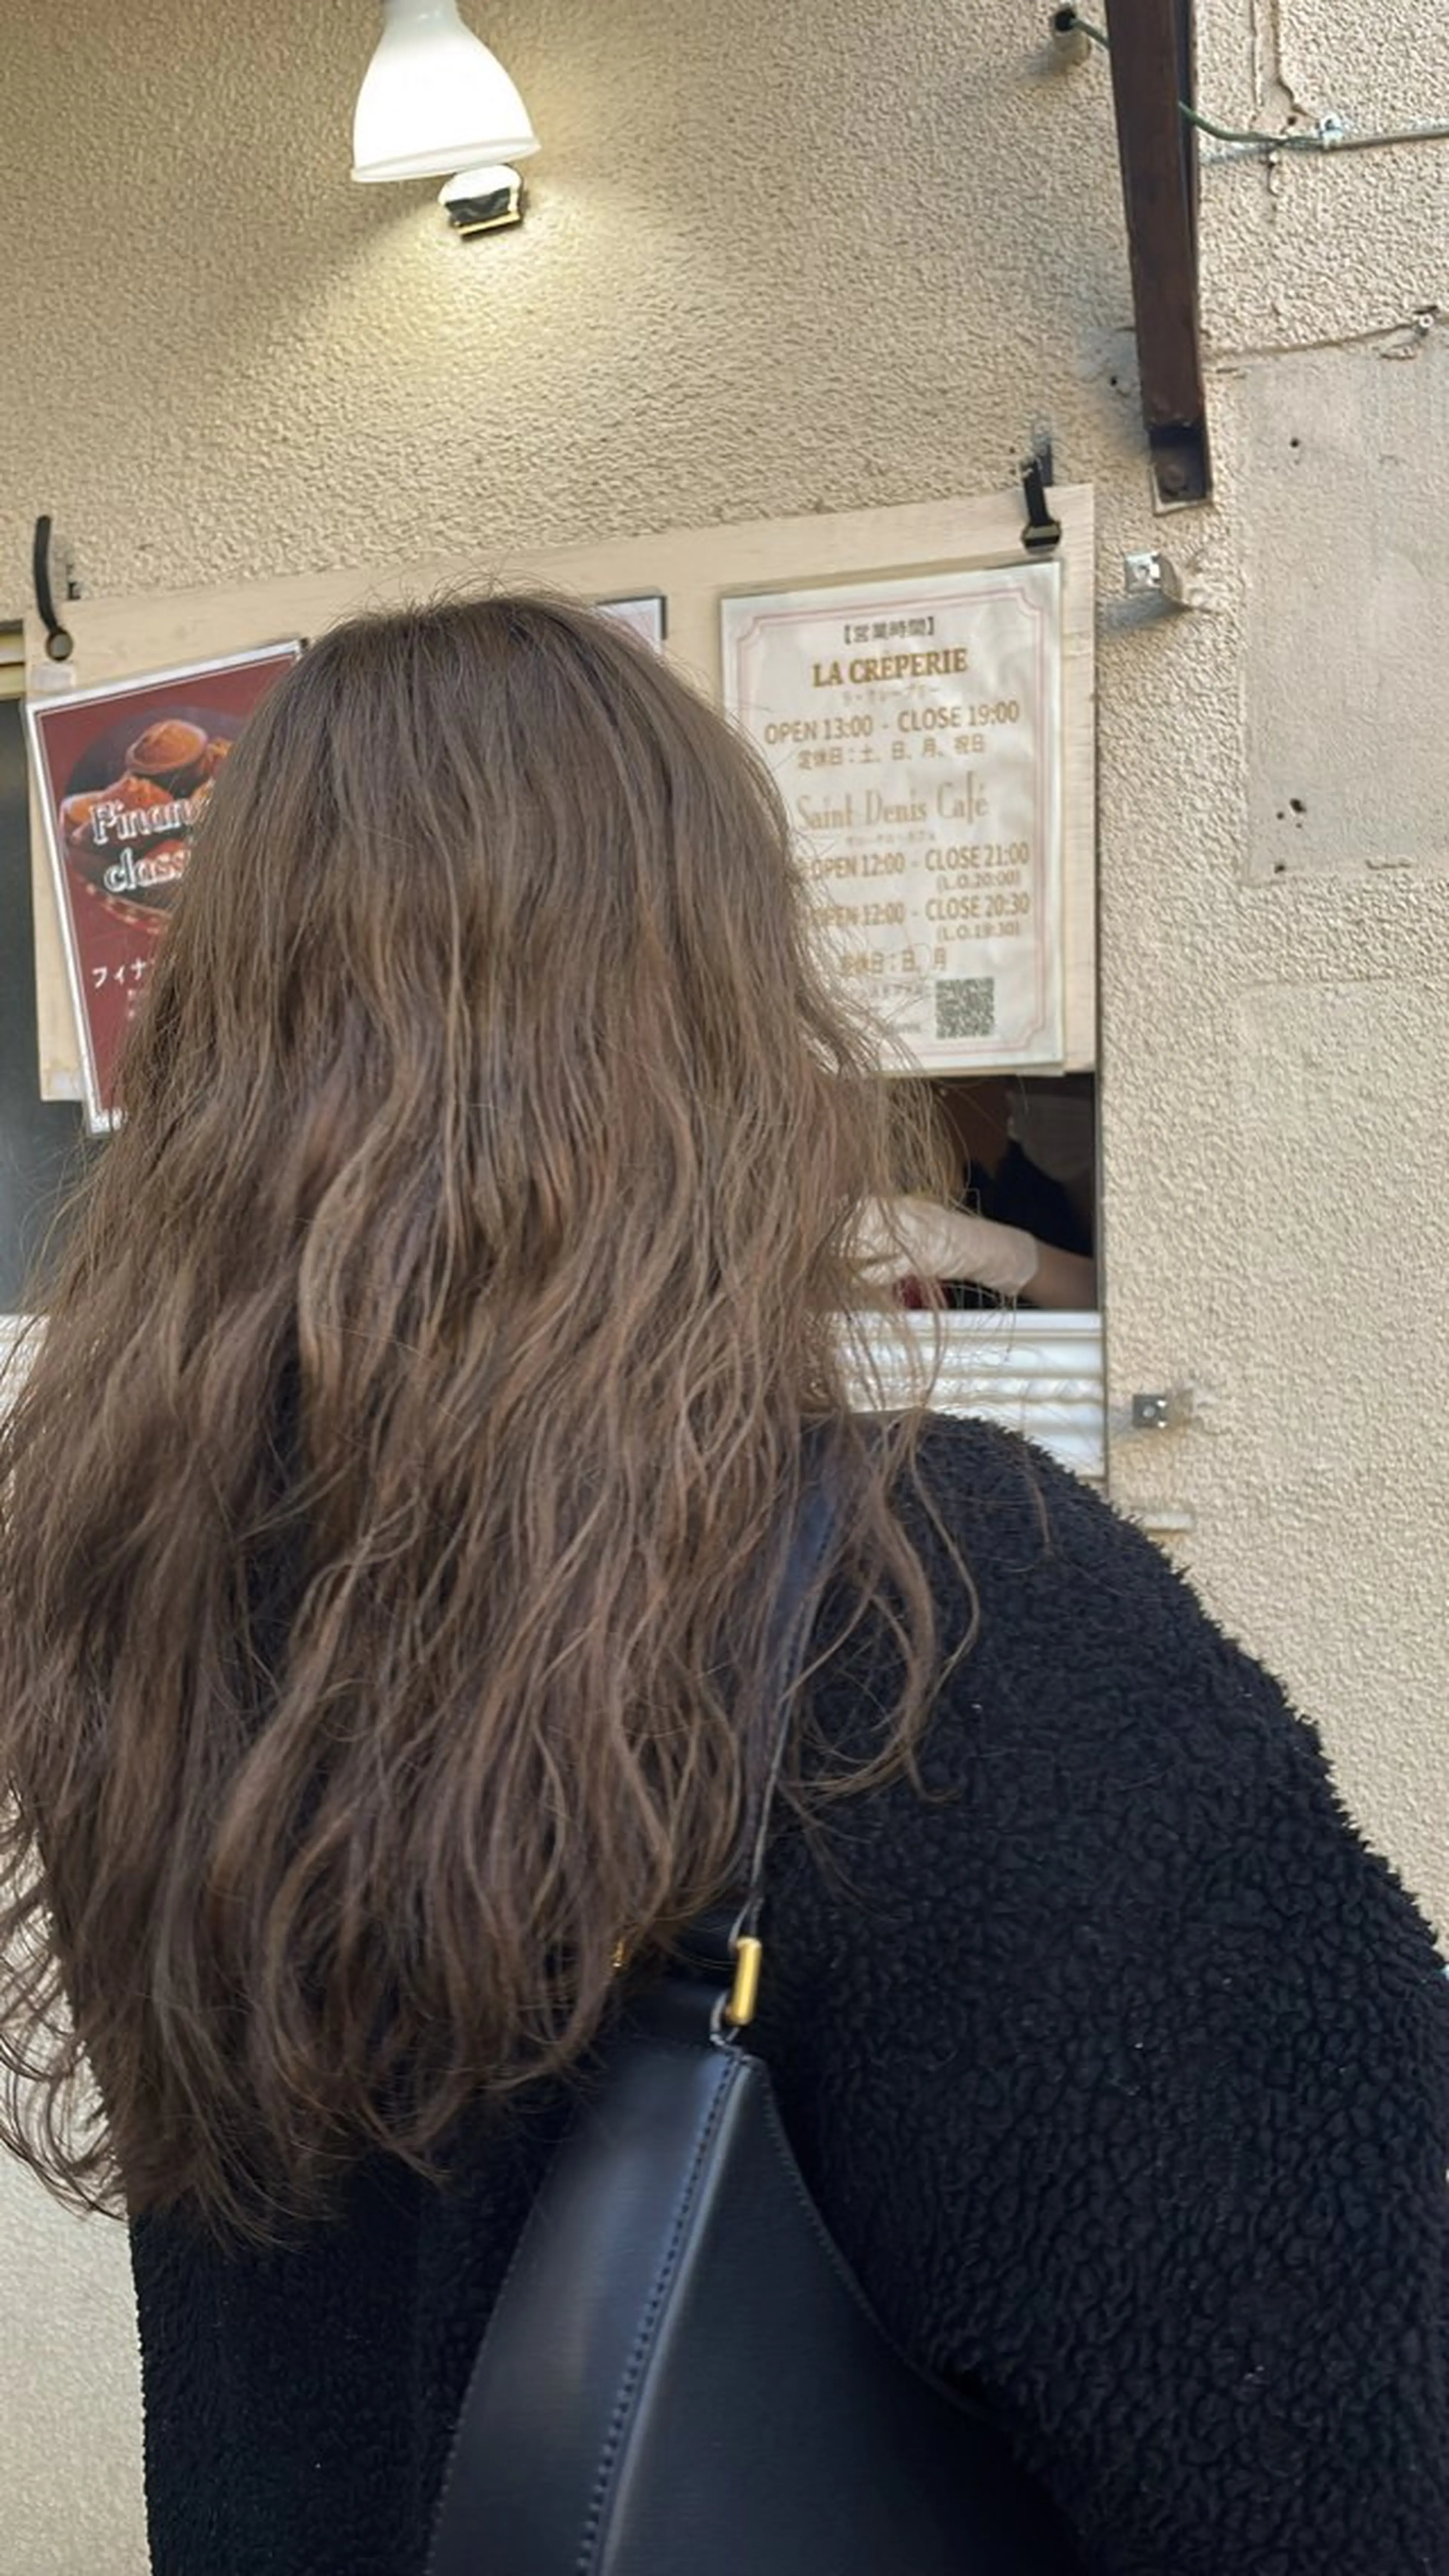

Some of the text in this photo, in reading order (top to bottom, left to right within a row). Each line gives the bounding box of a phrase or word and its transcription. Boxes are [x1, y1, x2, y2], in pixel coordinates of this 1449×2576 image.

[812, 660, 844, 688] LA
[764, 720, 817, 745] OPEN
[824, 714, 874, 740] 13:00
[897, 706, 962, 733] CLOSE
[968, 700, 1020, 727] 19:00
[796, 791, 854, 831] Saint
[866, 787, 927, 826] Denis
[861, 851, 906, 878] 12:00
[924, 846, 980, 871] CLOSE
[983, 841, 1030, 867] 21:00
[924, 894, 980, 921] CLOSE
[983, 890, 1030, 918] 20:30
